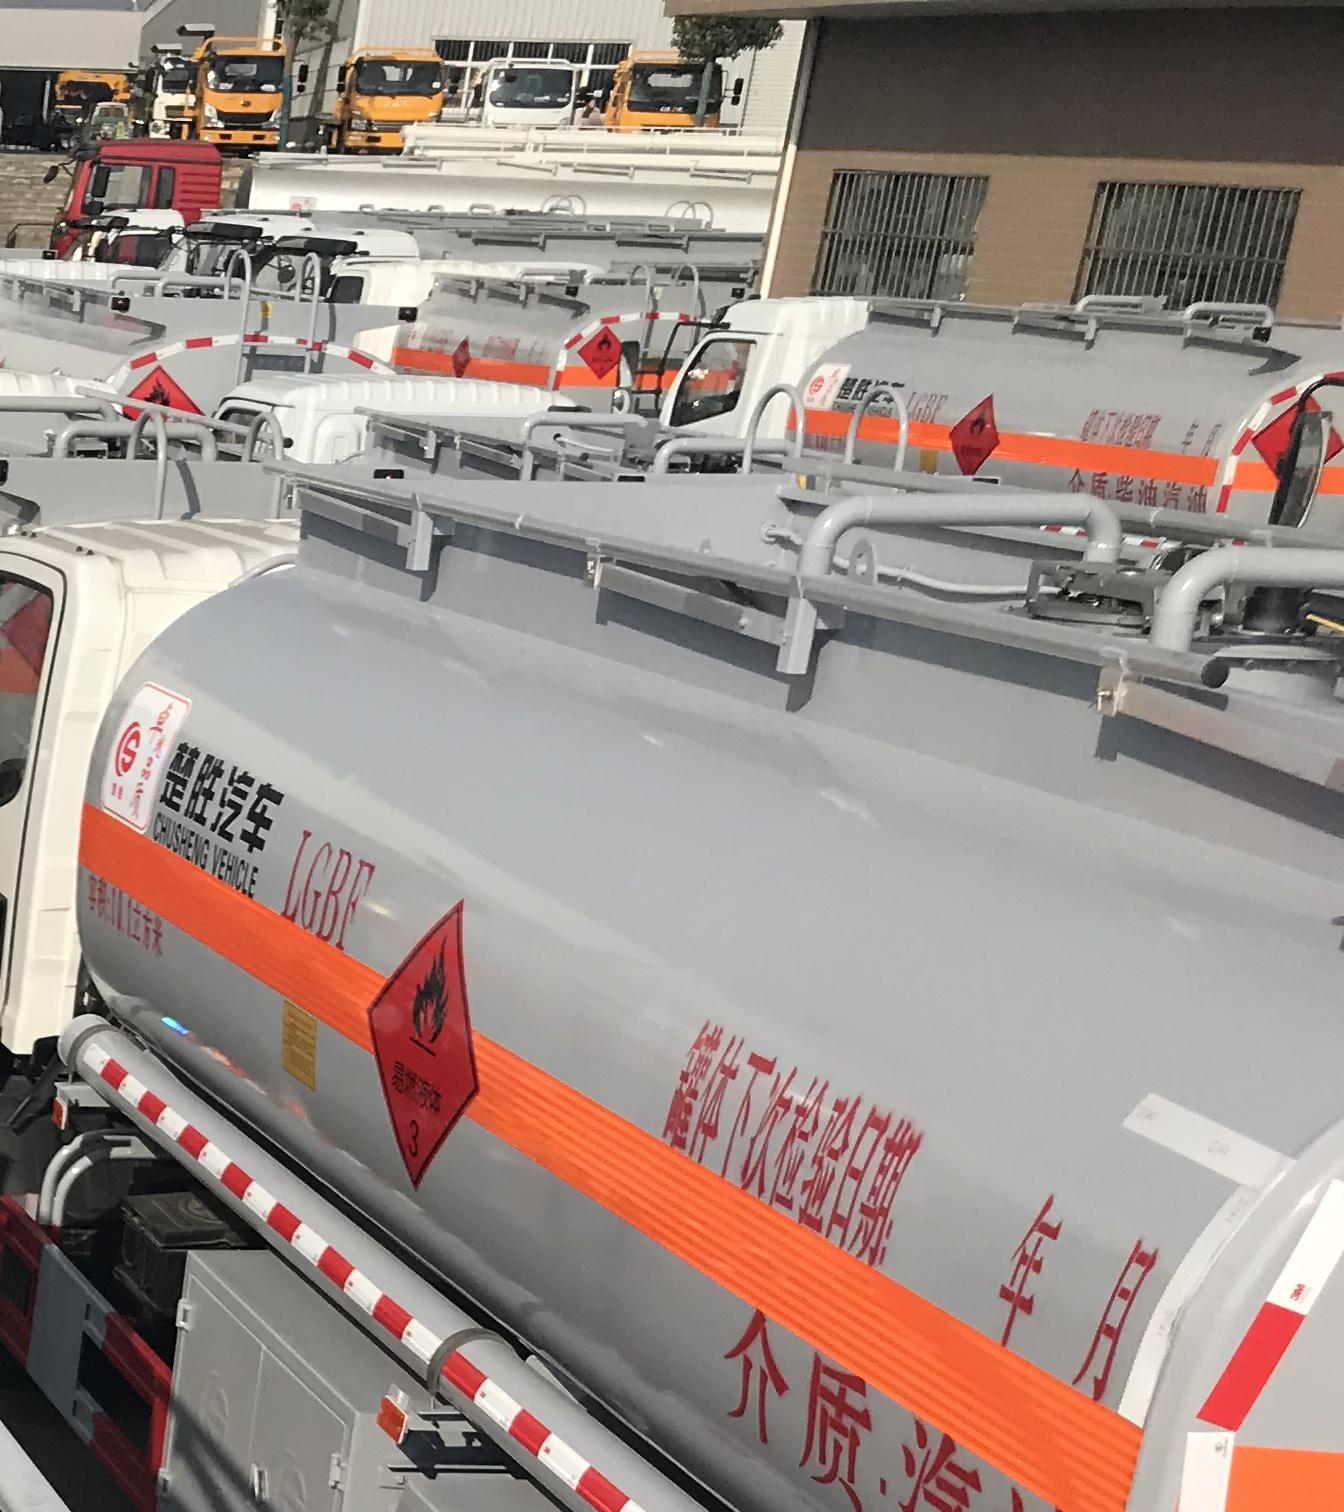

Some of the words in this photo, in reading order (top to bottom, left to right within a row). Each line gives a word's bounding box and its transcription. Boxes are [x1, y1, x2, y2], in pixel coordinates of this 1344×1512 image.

[159, 741, 286, 854] 楚胜汽车
[152, 812, 210, 870] CHUSHENG
[211, 847, 260, 899] VEHICLE
[281, 829, 376, 951] LGBF
[408, 1118, 420, 1158] 3
[998, 1192, 1063, 1348] 年
[1071, 1237, 1159, 1403] 月
